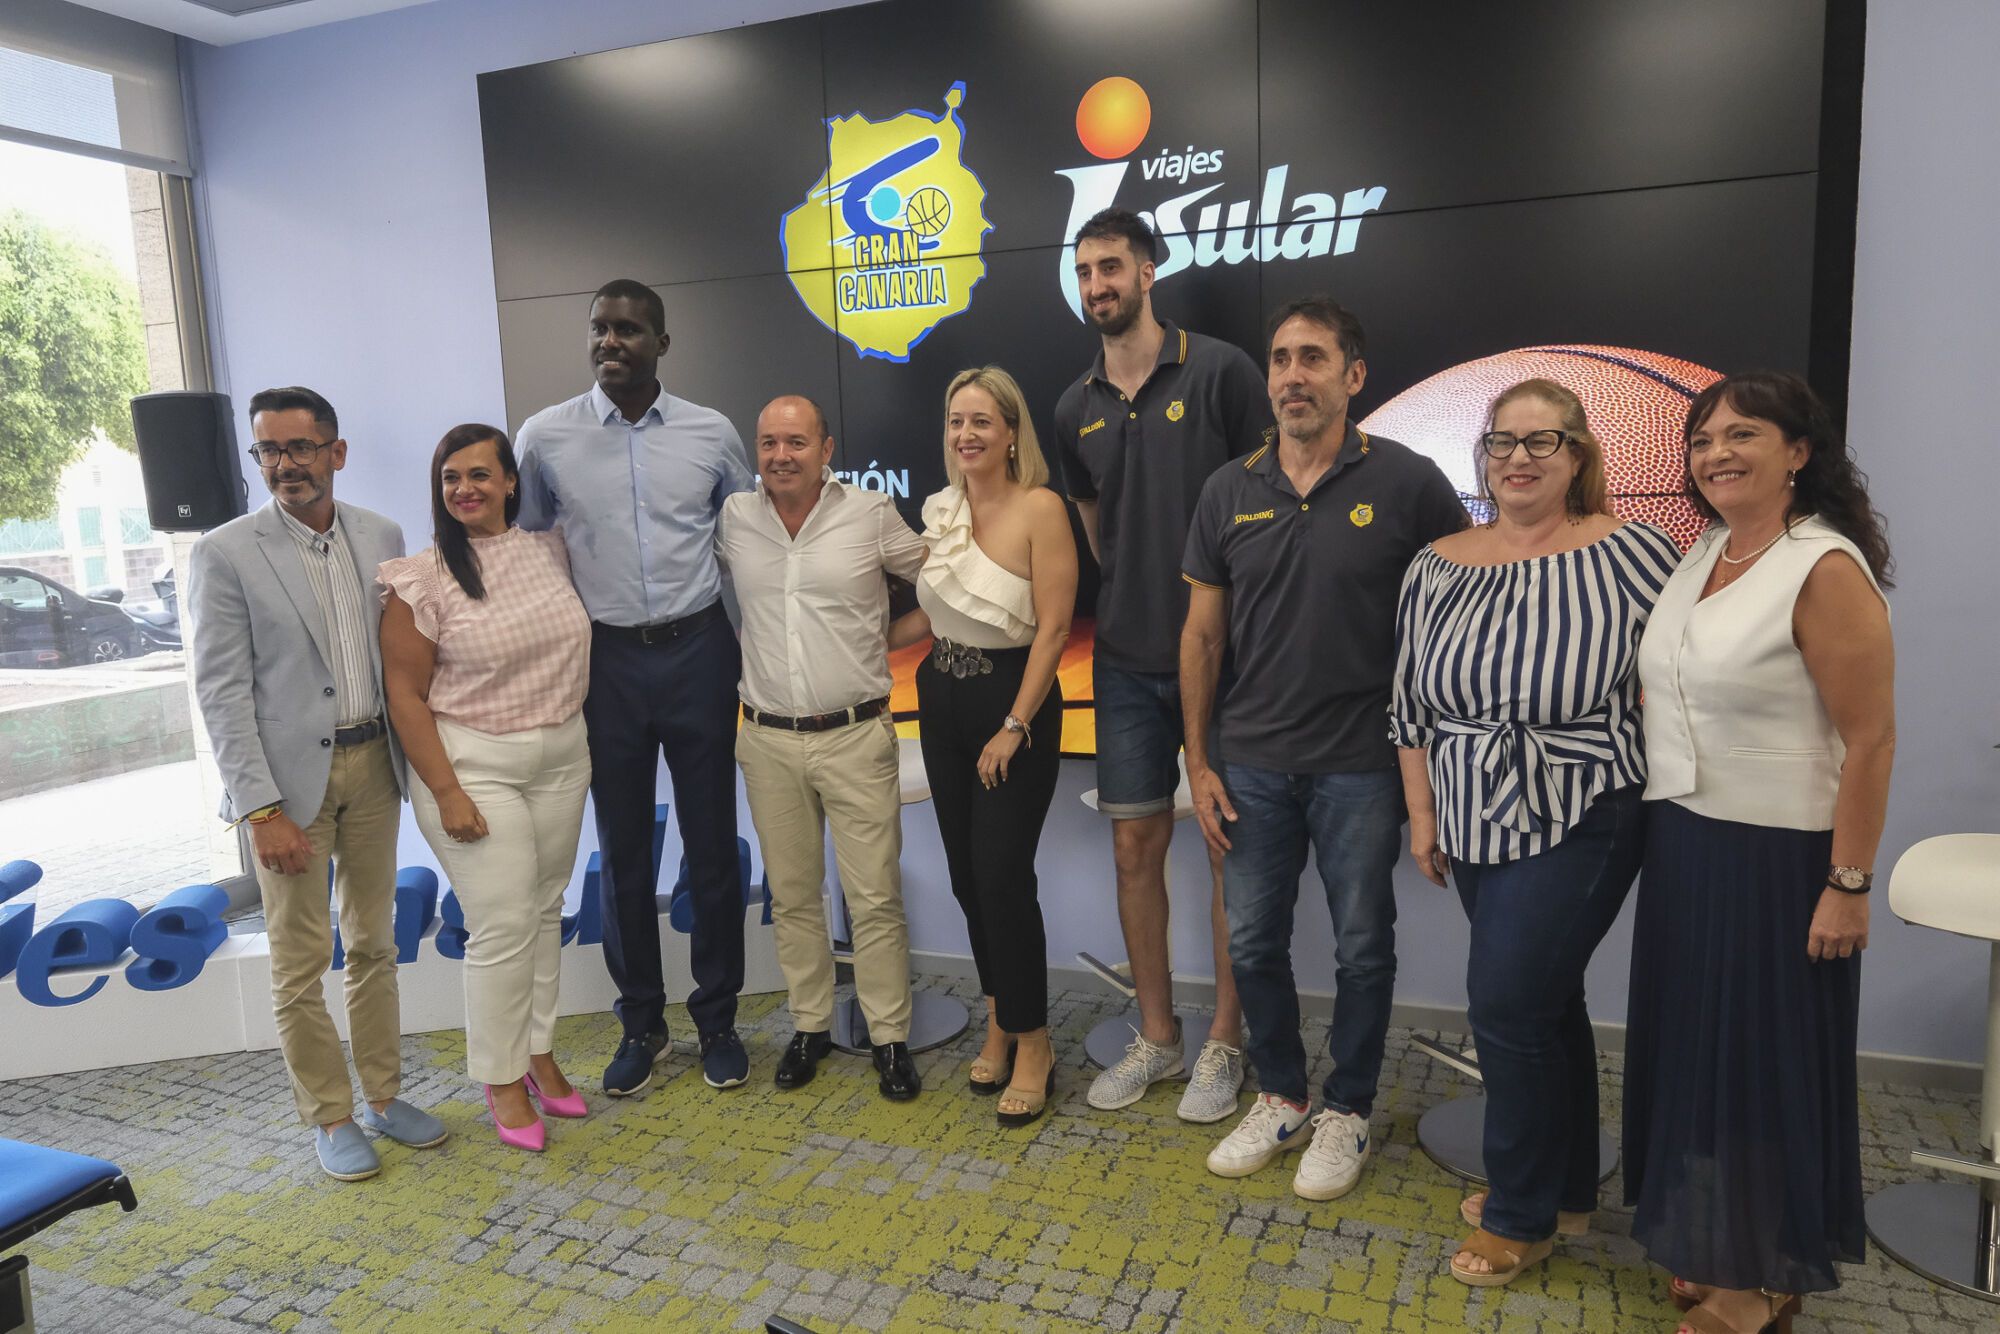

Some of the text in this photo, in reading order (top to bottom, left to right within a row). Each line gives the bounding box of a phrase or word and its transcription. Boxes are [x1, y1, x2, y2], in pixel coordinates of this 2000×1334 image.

[1142, 146, 1224, 184] viajes
[855, 231, 920, 272] GRAN
[840, 267, 946, 311] CANARIA
[1235, 509, 1274, 525] SPALDING
